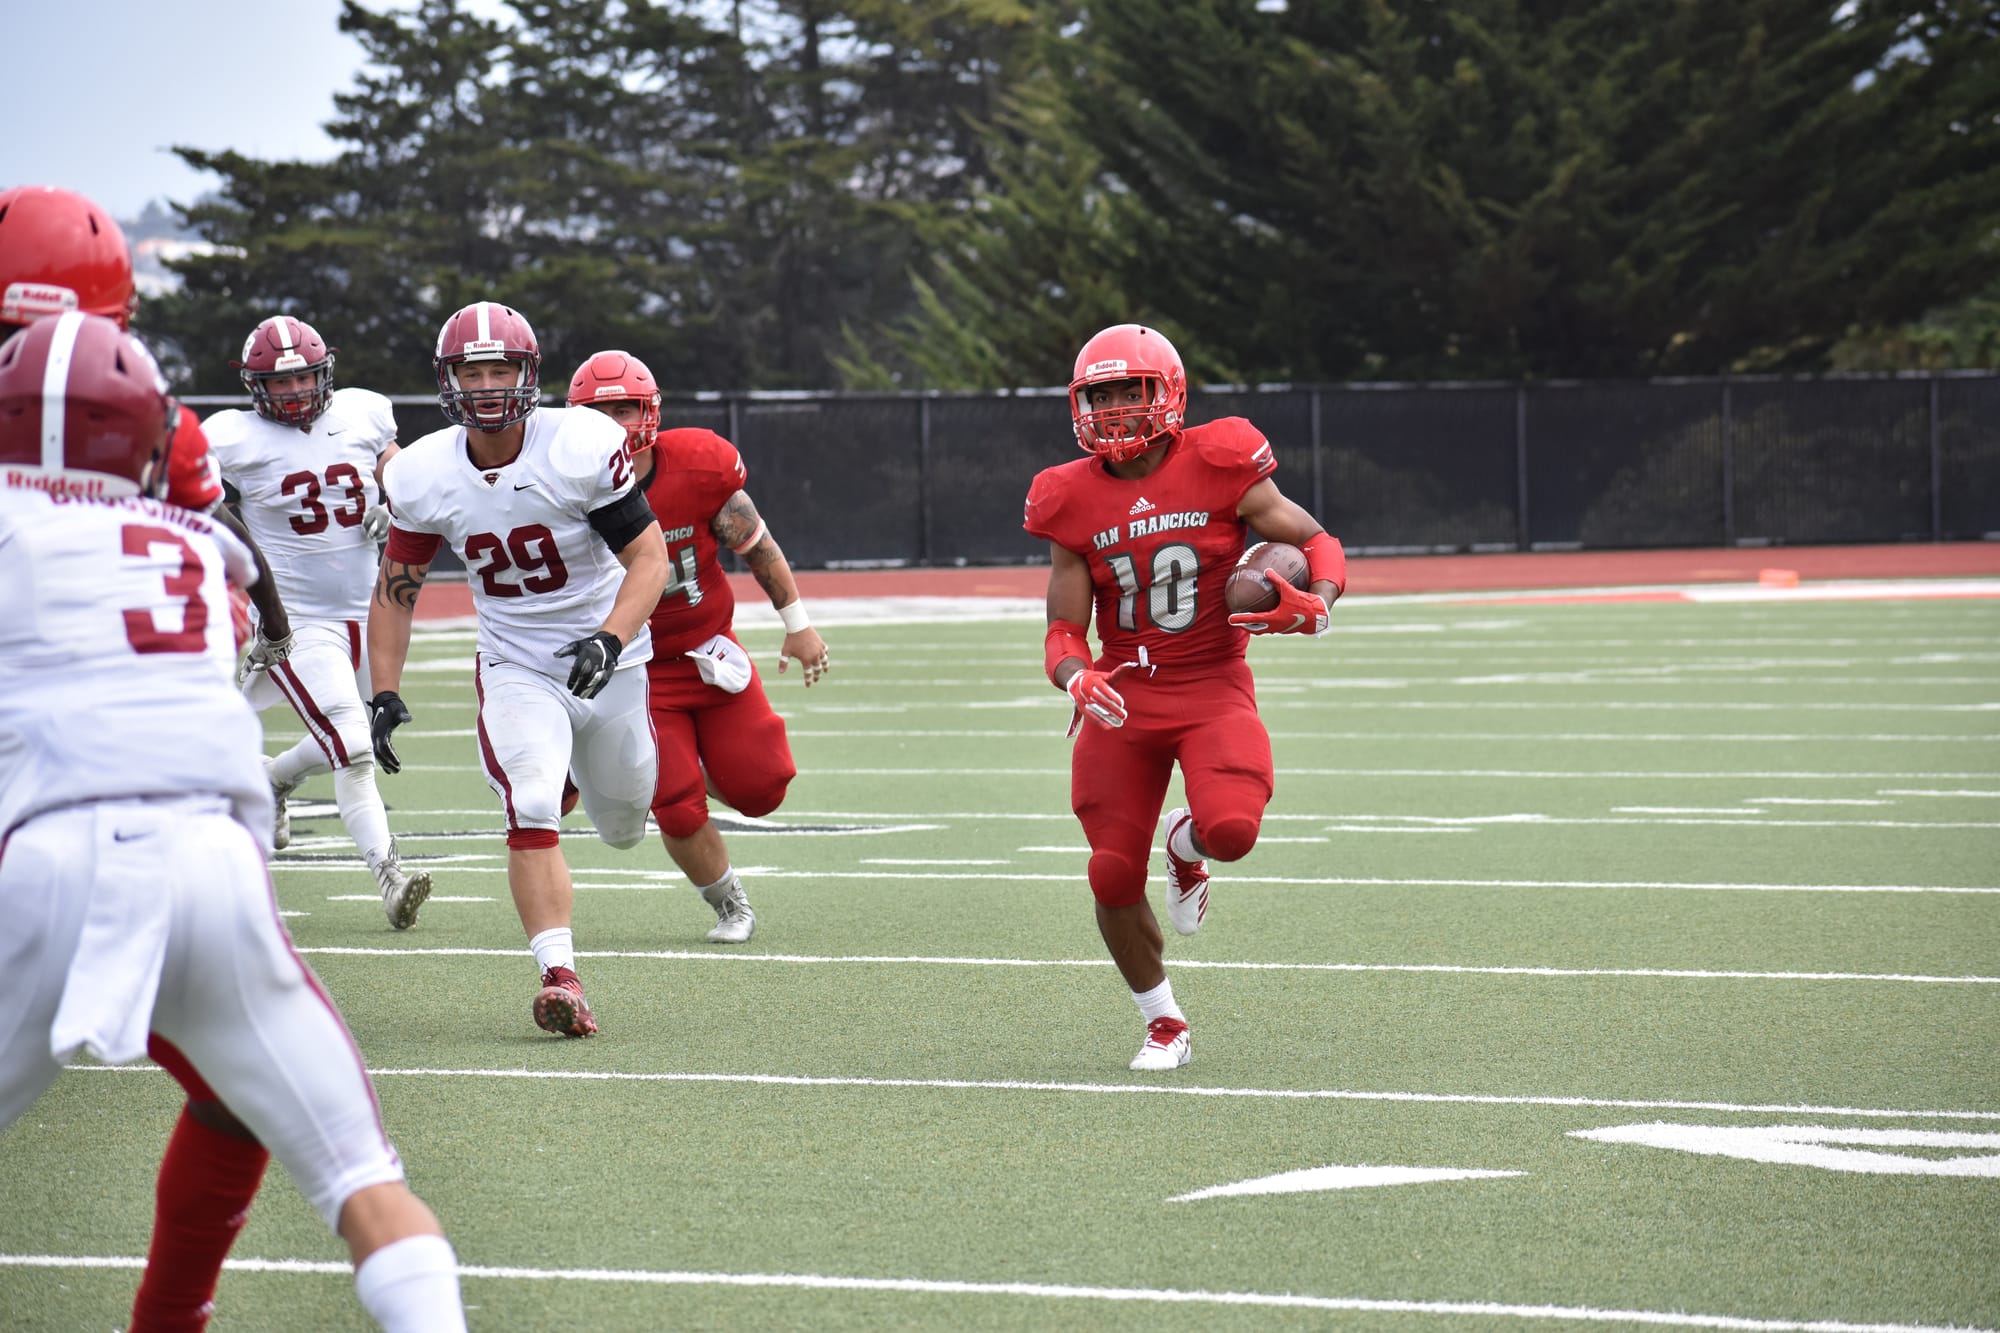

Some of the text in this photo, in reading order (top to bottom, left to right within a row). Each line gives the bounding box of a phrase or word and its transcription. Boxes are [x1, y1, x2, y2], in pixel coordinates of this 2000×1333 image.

[473, 341, 496, 349] Riddell
[1095, 362, 1118, 371] Riddell
[7, 470, 105, 495] Riddell
[281, 463, 367, 534] 33
[1129, 503, 1156, 515] adidas
[663, 525, 694, 543] CISCO
[1093, 511, 1209, 550] SAN FRANCISCO
[465, 524, 569, 597] 29
[663, 544, 704, 607] 4
[121, 523, 208, 653] 3
[1103, 542, 1202, 634] 10
